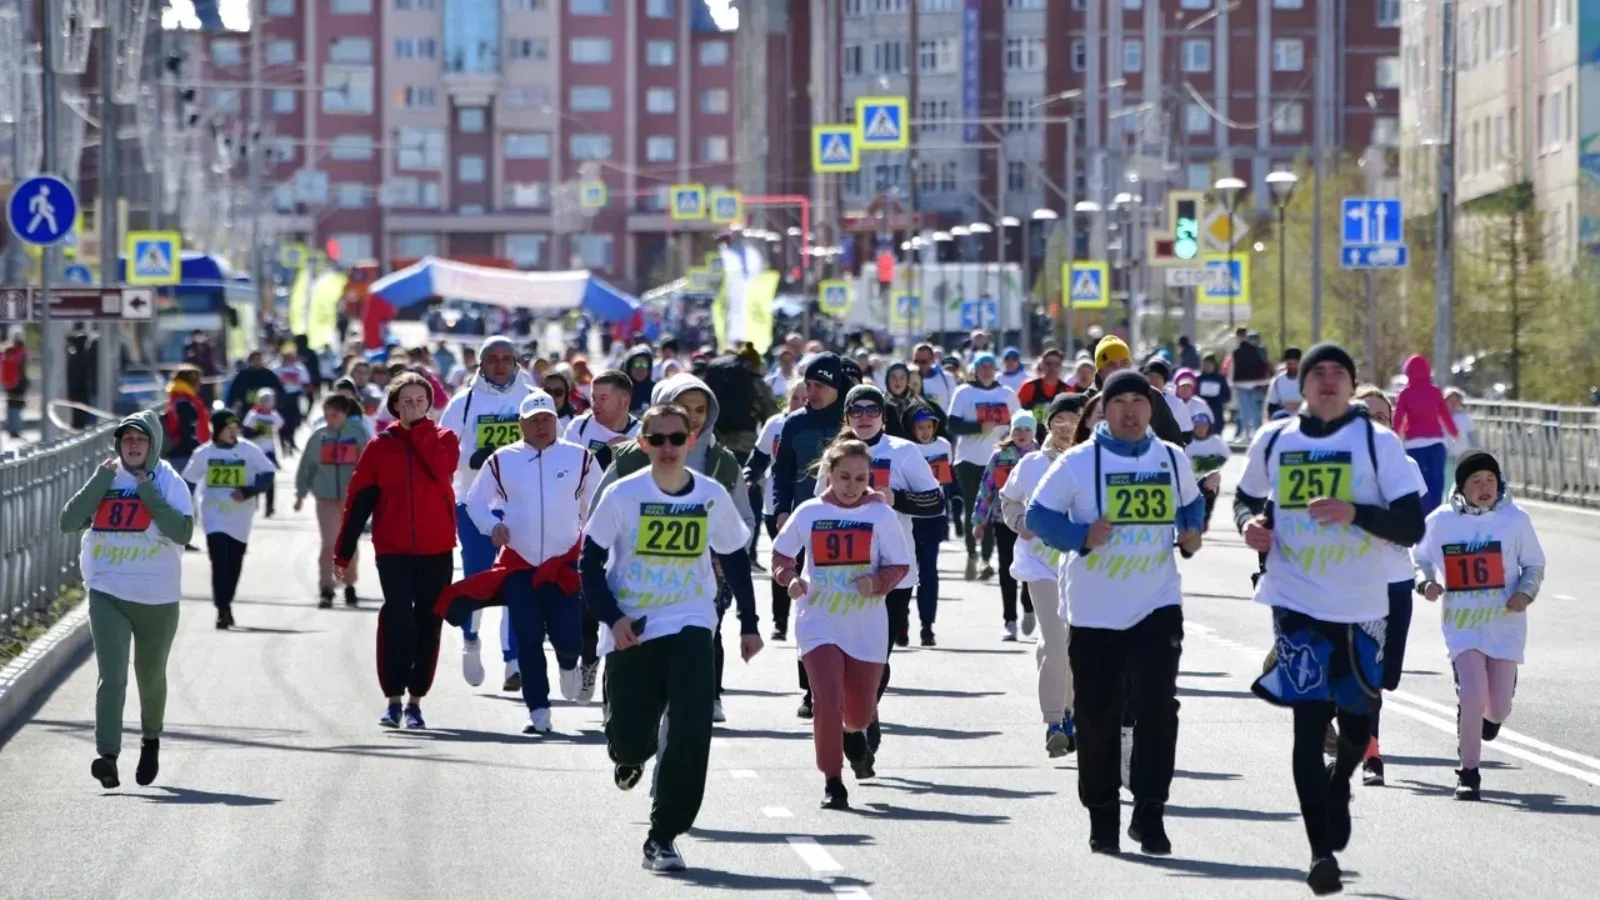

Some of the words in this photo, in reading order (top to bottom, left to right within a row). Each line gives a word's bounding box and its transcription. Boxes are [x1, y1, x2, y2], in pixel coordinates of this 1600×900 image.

[483, 424, 521, 447] 225
[211, 468, 240, 485] 221
[1288, 467, 1342, 502] 257
[109, 502, 139, 527] 87
[1116, 488, 1167, 519] 233
[646, 519, 701, 551] 220
[826, 532, 854, 560] 91
[1106, 527, 1165, 545] МАЛ
[1458, 556, 1490, 585] 16
